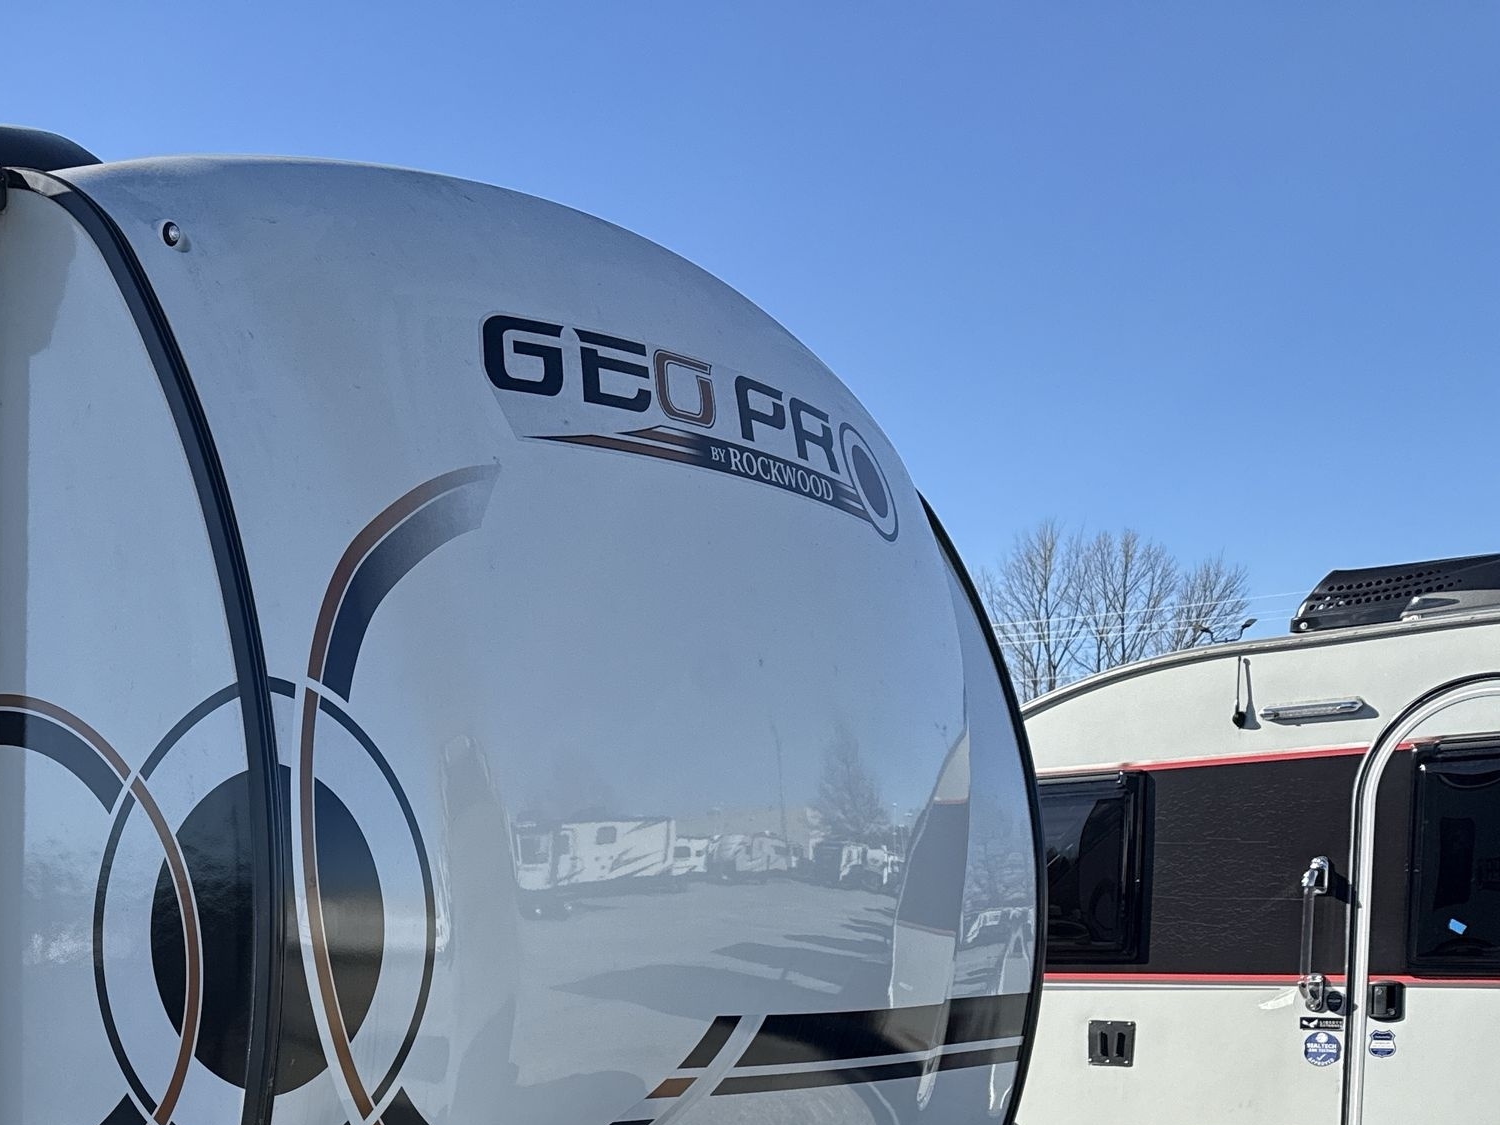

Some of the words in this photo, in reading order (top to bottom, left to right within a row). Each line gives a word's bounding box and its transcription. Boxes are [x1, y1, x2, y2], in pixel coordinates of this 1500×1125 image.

[482, 315, 717, 429] GEO
[734, 375, 899, 543] PRO
[710, 445, 727, 464] BY
[728, 446, 834, 502] ROCKWOOD
